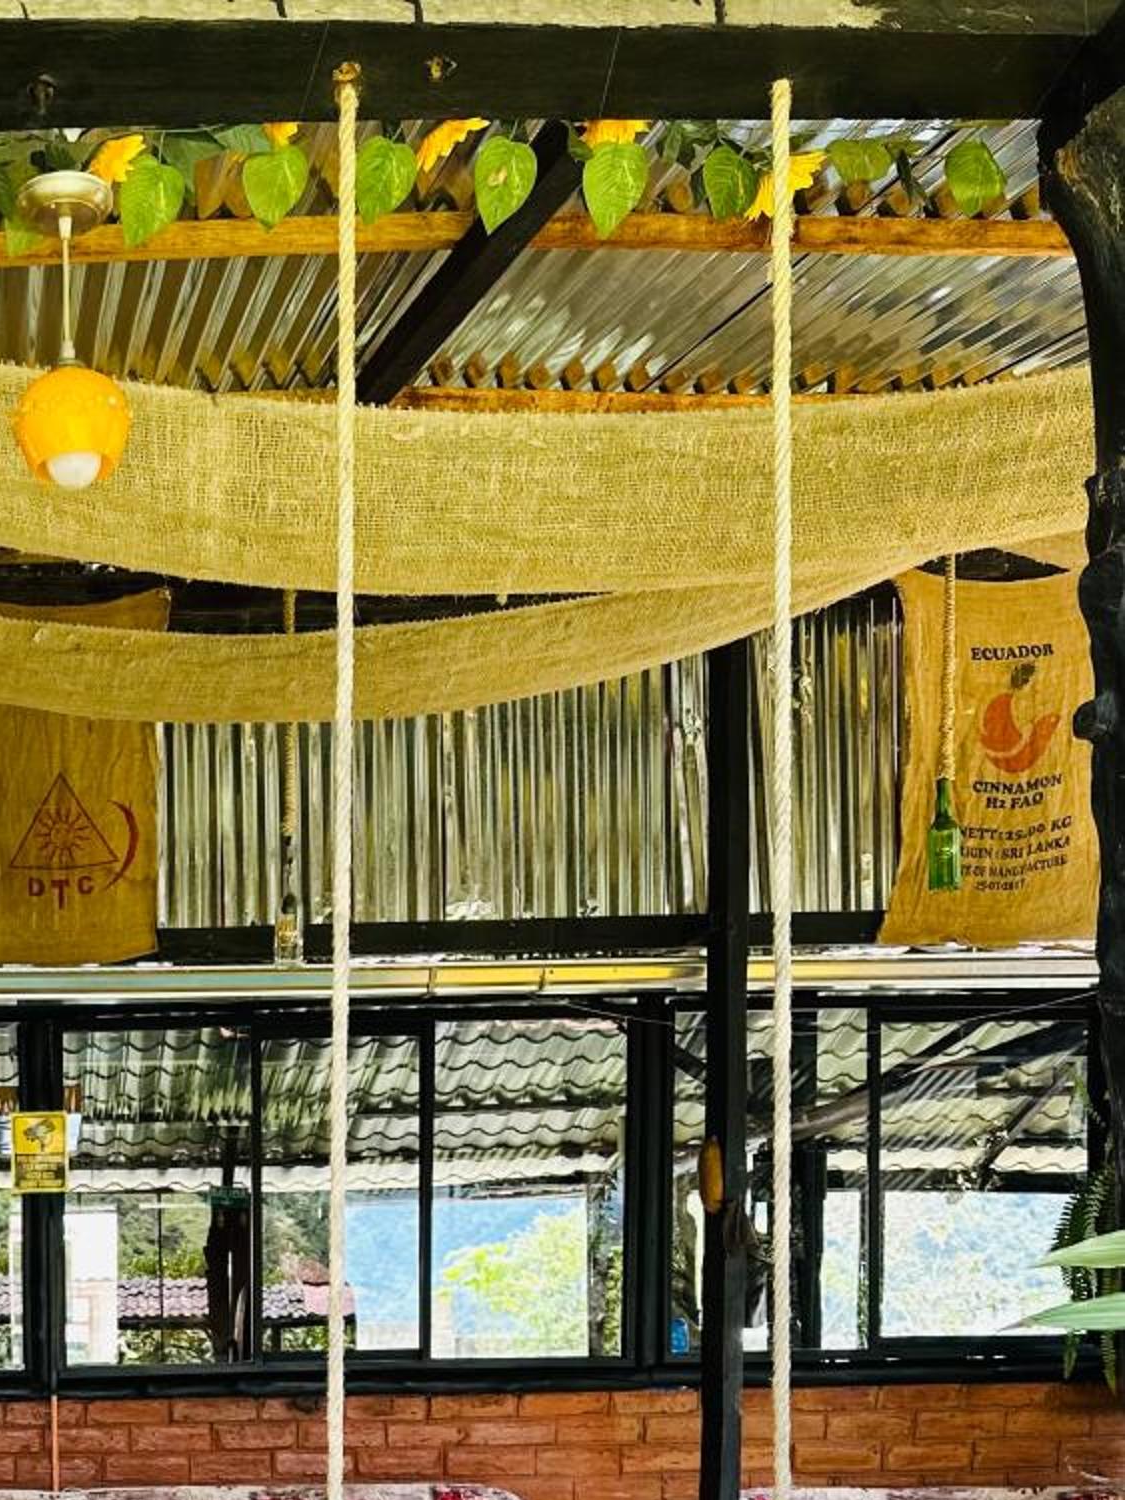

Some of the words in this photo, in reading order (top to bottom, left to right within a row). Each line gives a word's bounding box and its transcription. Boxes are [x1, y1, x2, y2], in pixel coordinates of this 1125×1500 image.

[971, 643, 1054, 660] ECUADOR
[972, 773, 1062, 794] CINNAMON
[986, 796, 1006, 809] H2
[1026, 835, 1070, 857] LANKA
